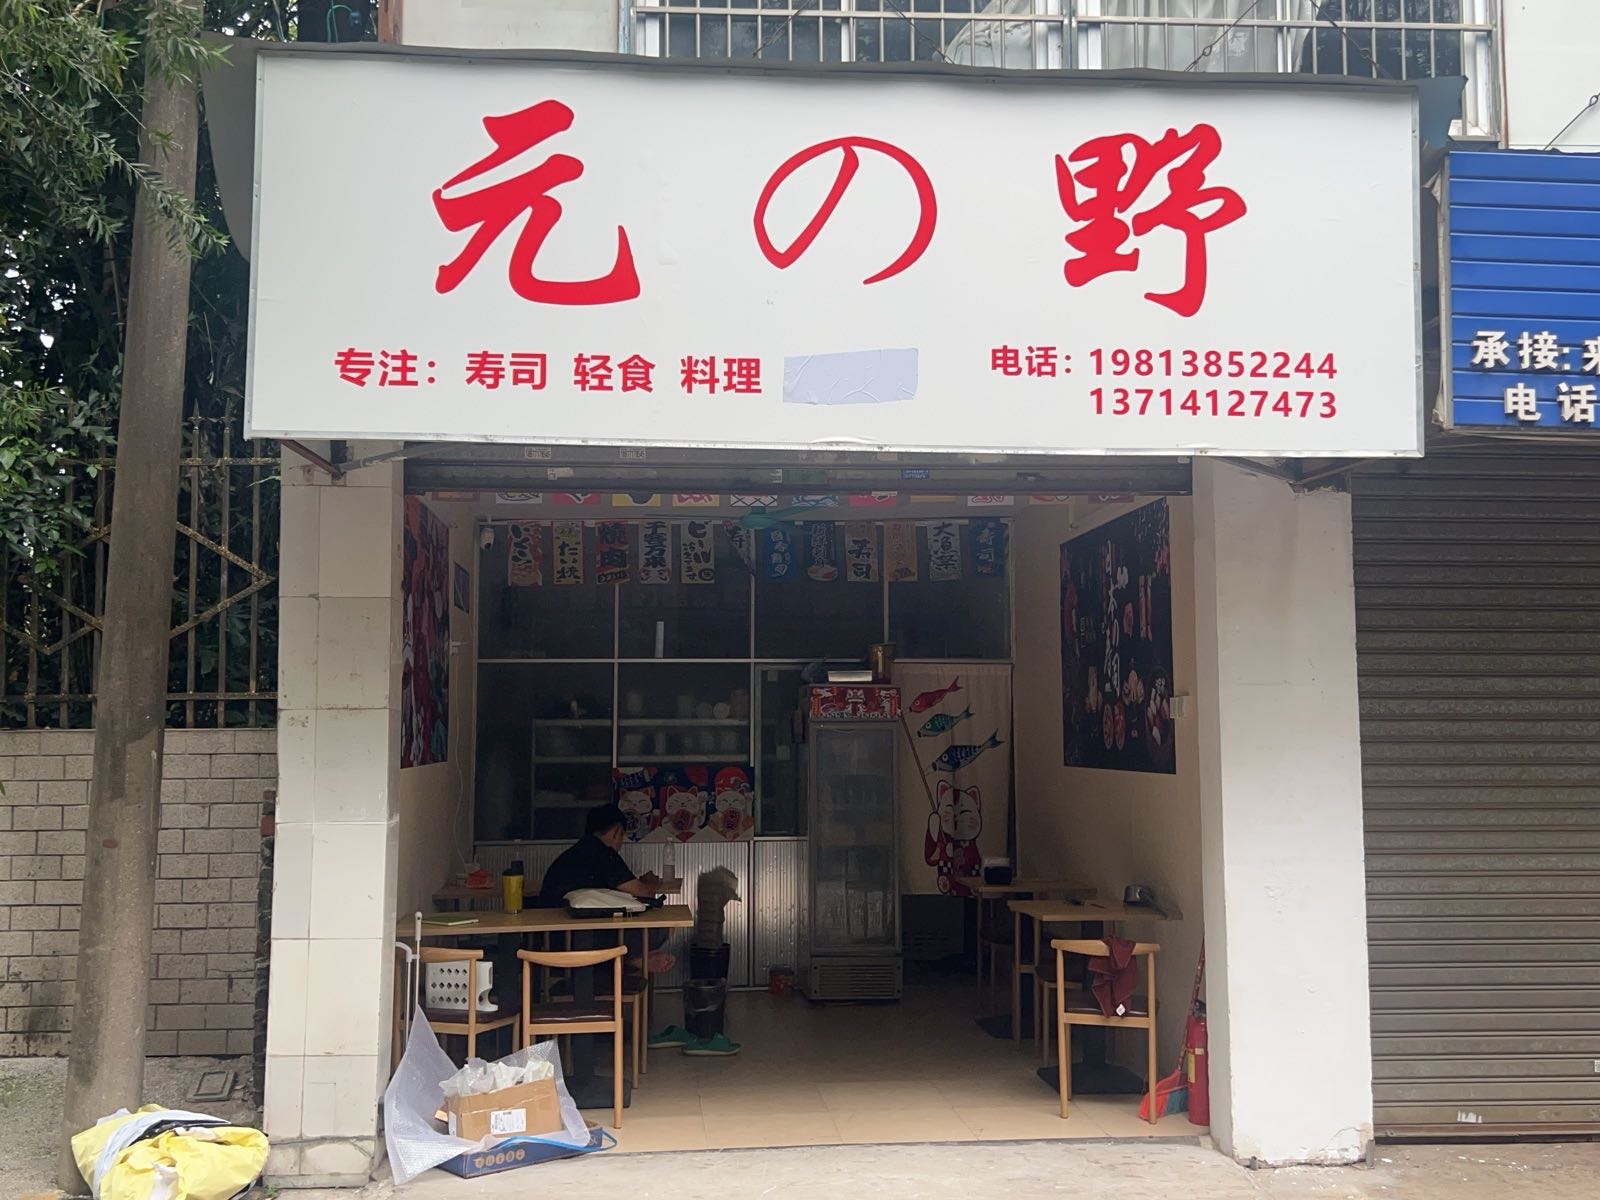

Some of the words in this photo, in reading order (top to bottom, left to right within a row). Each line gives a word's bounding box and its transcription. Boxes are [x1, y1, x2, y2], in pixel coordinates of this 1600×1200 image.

[465, 350, 548, 391] 寿司
[573, 352, 656, 393] 轻食
[680, 355, 763, 395] 料理
[1090, 348, 1337, 379] 19813852244
[1090, 387, 1337, 419] 13714127473
[1504, 382, 1597, 423] 电话
